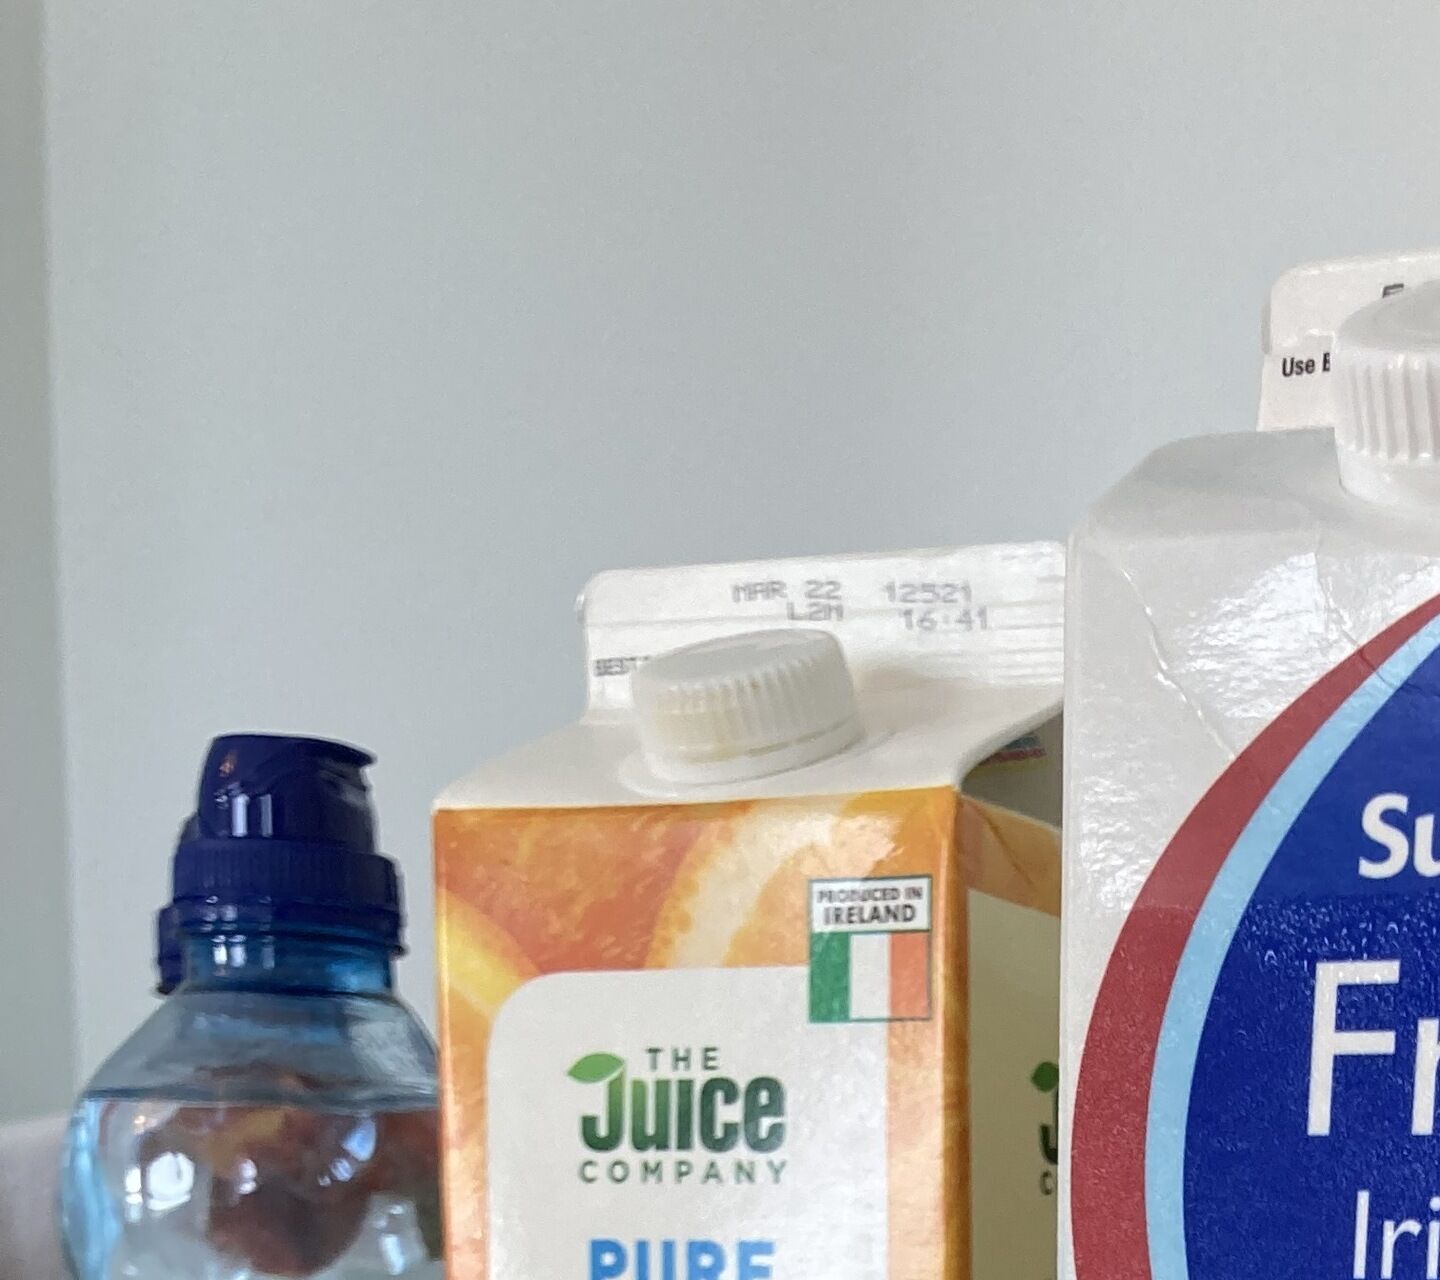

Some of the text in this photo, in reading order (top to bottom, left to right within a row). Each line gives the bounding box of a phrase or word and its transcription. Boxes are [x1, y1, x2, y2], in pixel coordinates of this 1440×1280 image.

[1282, 357, 1315, 377] Use
[732, 581, 787, 602] MAR
[805, 579, 842, 600] 22
[816, 886, 924, 904] PRODUCED IN
[823, 904, 916, 925] IRELAND
[645, 1046, 721, 1072] THE
[578, 1158, 789, 1186] COMPANY
